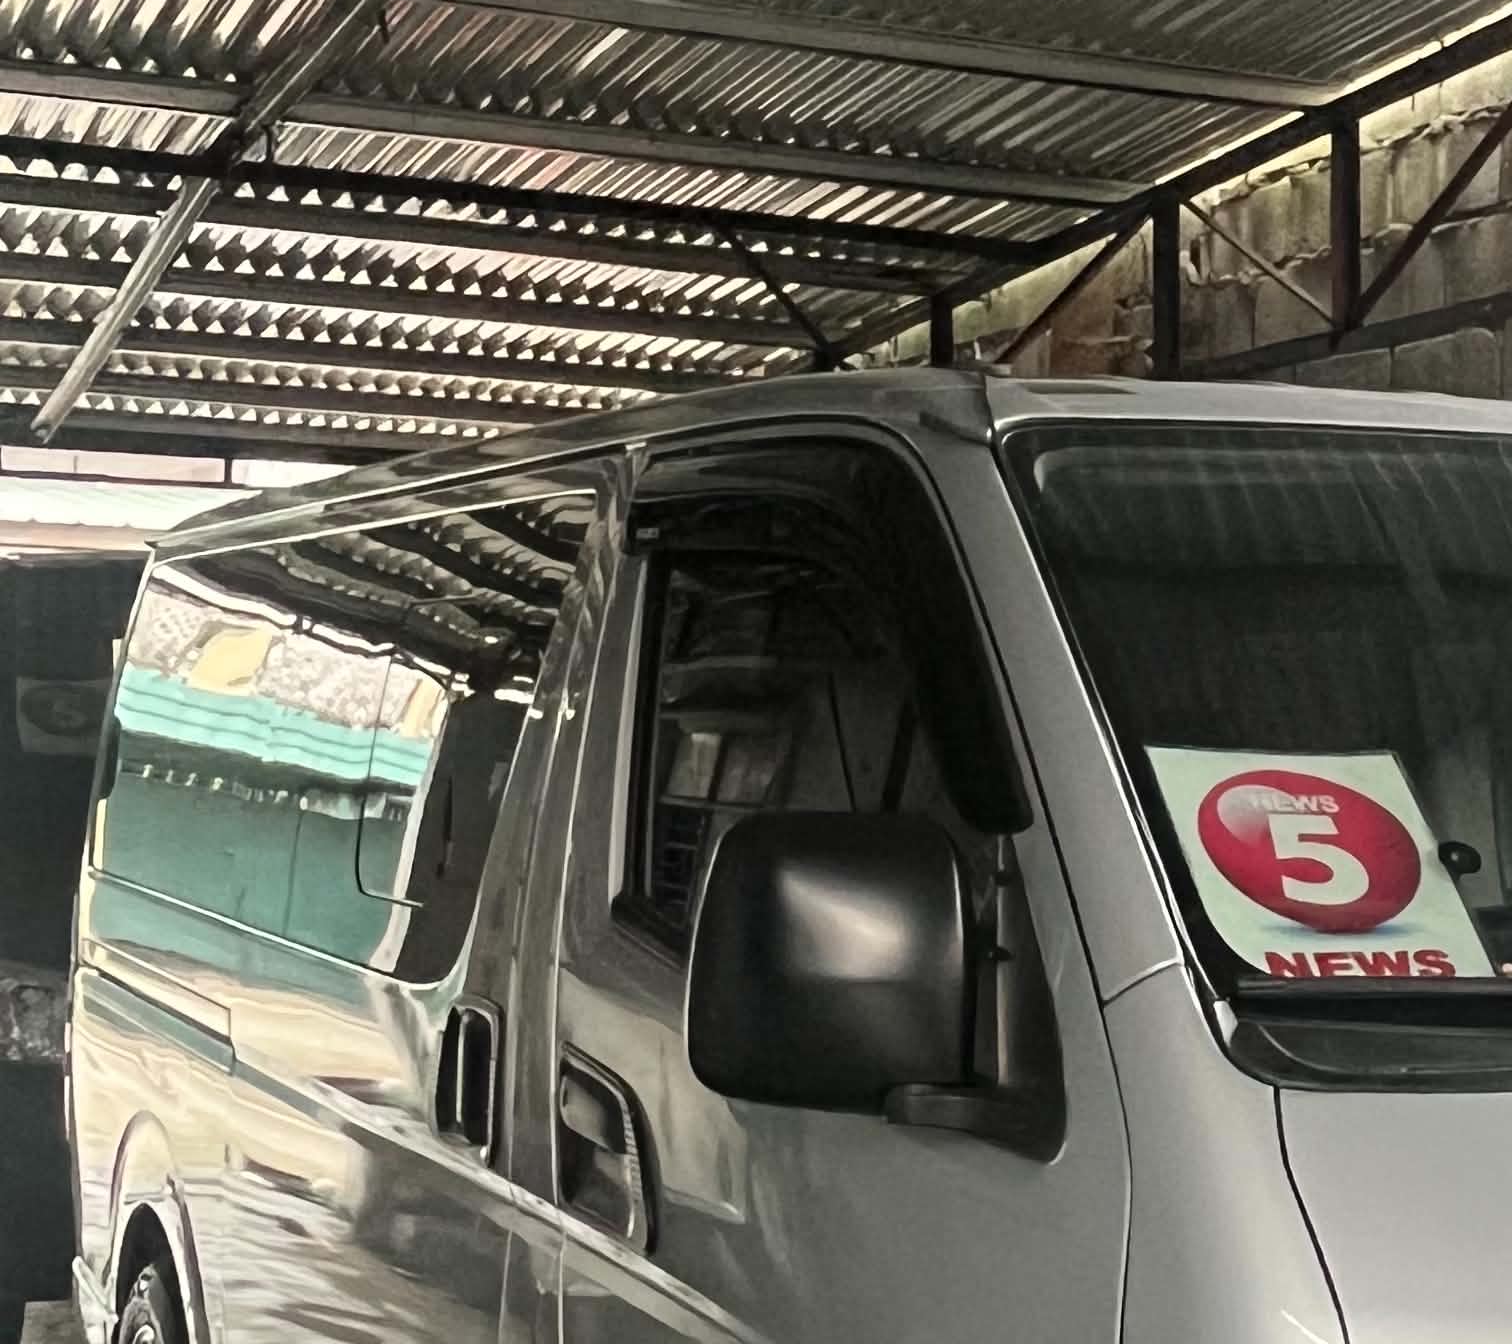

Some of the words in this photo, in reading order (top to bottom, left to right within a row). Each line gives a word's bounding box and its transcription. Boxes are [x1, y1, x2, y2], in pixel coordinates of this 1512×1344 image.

[1248, 794, 1340, 814] NEWS
[1267, 814, 1369, 905] 5
[1265, 950, 1456, 977] NEWS
